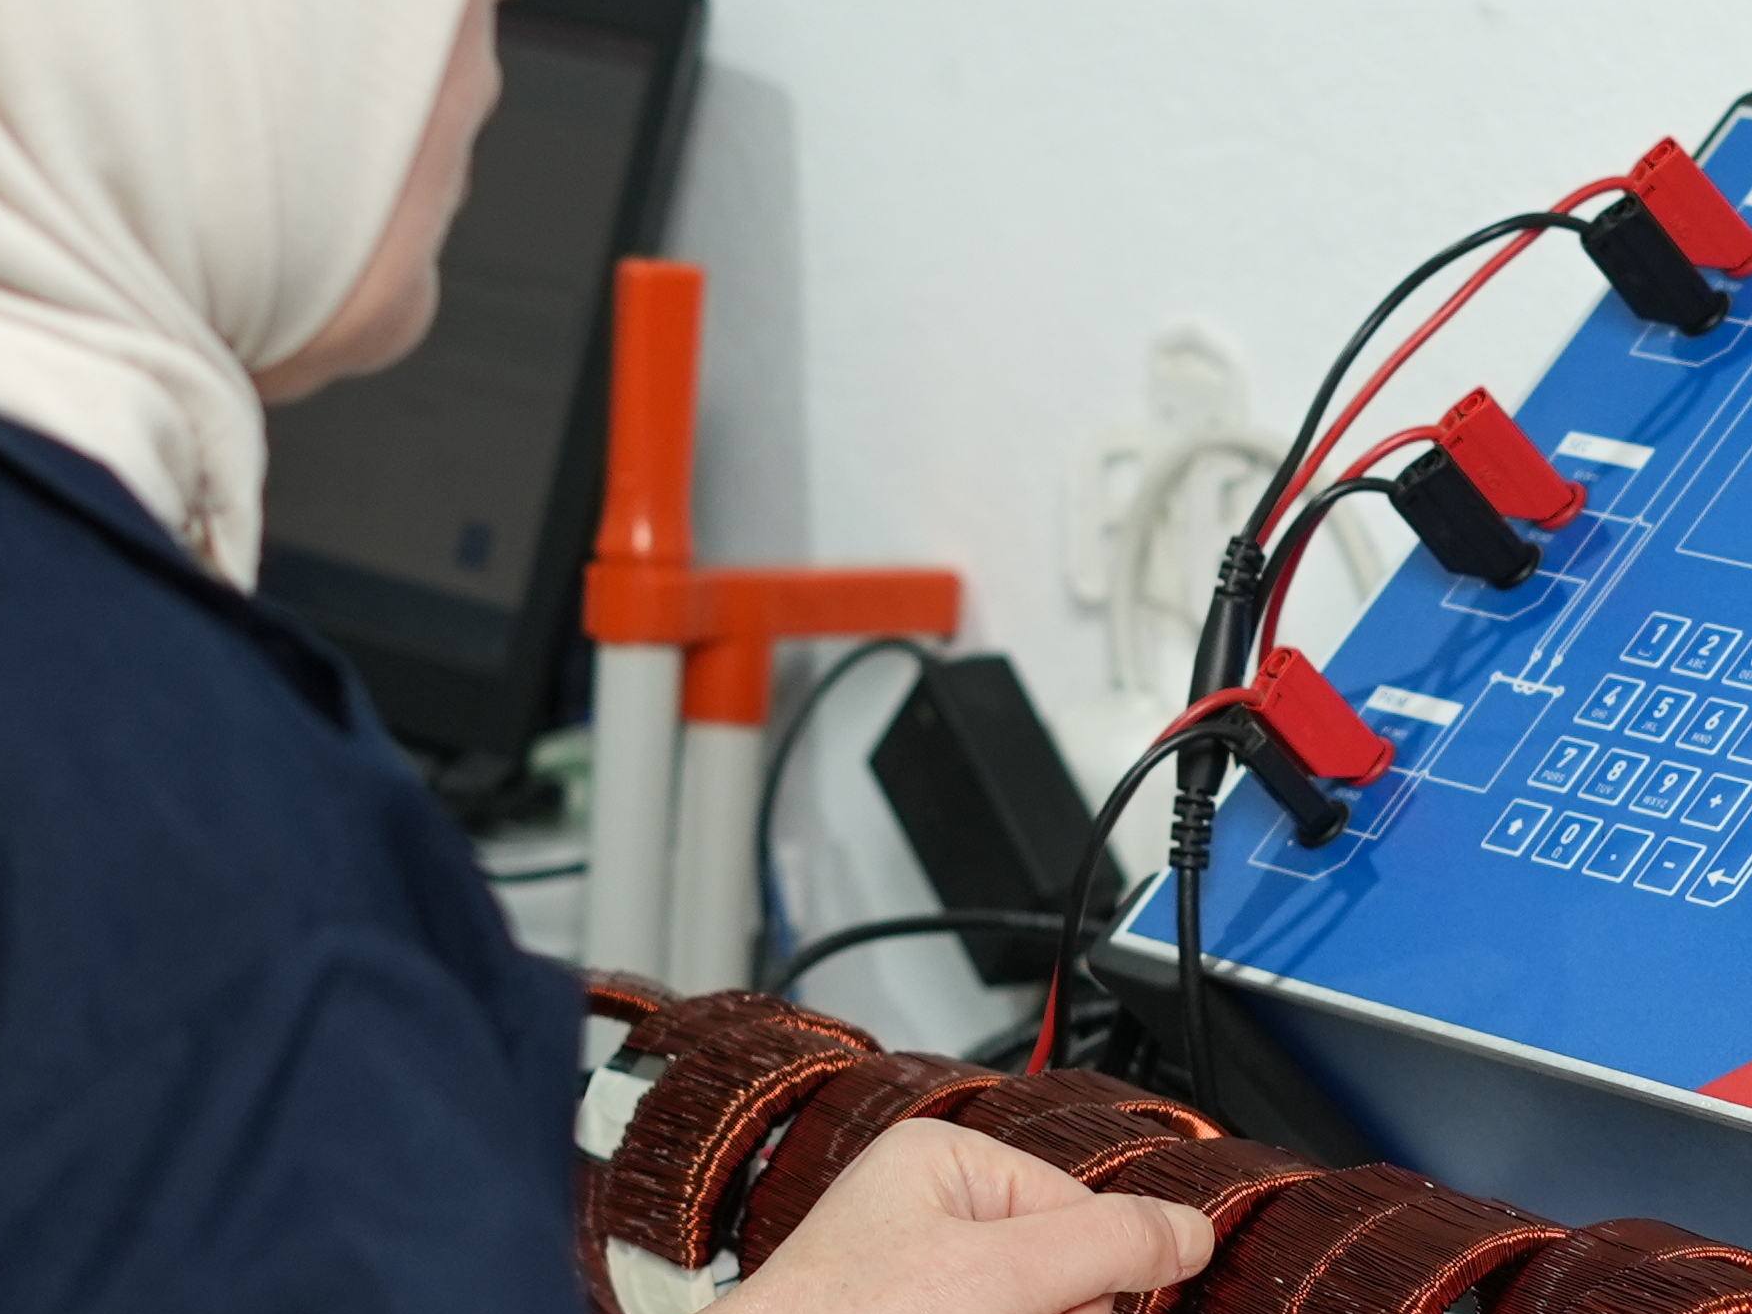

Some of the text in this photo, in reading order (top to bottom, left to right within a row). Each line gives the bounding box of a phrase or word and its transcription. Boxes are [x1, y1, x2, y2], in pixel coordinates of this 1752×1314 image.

[1651, 623, 1668, 644] 1
[1698, 635, 1721, 656] 2
[1602, 686, 1624, 707] 4
[1653, 697, 1675, 718] 5
[1704, 709, 1725, 731] 6
[1556, 747, 1578, 768] 7
[1607, 760, 1628, 782] 8
[1660, 773, 1680, 794] 9
[1561, 823, 1581, 844] 0
